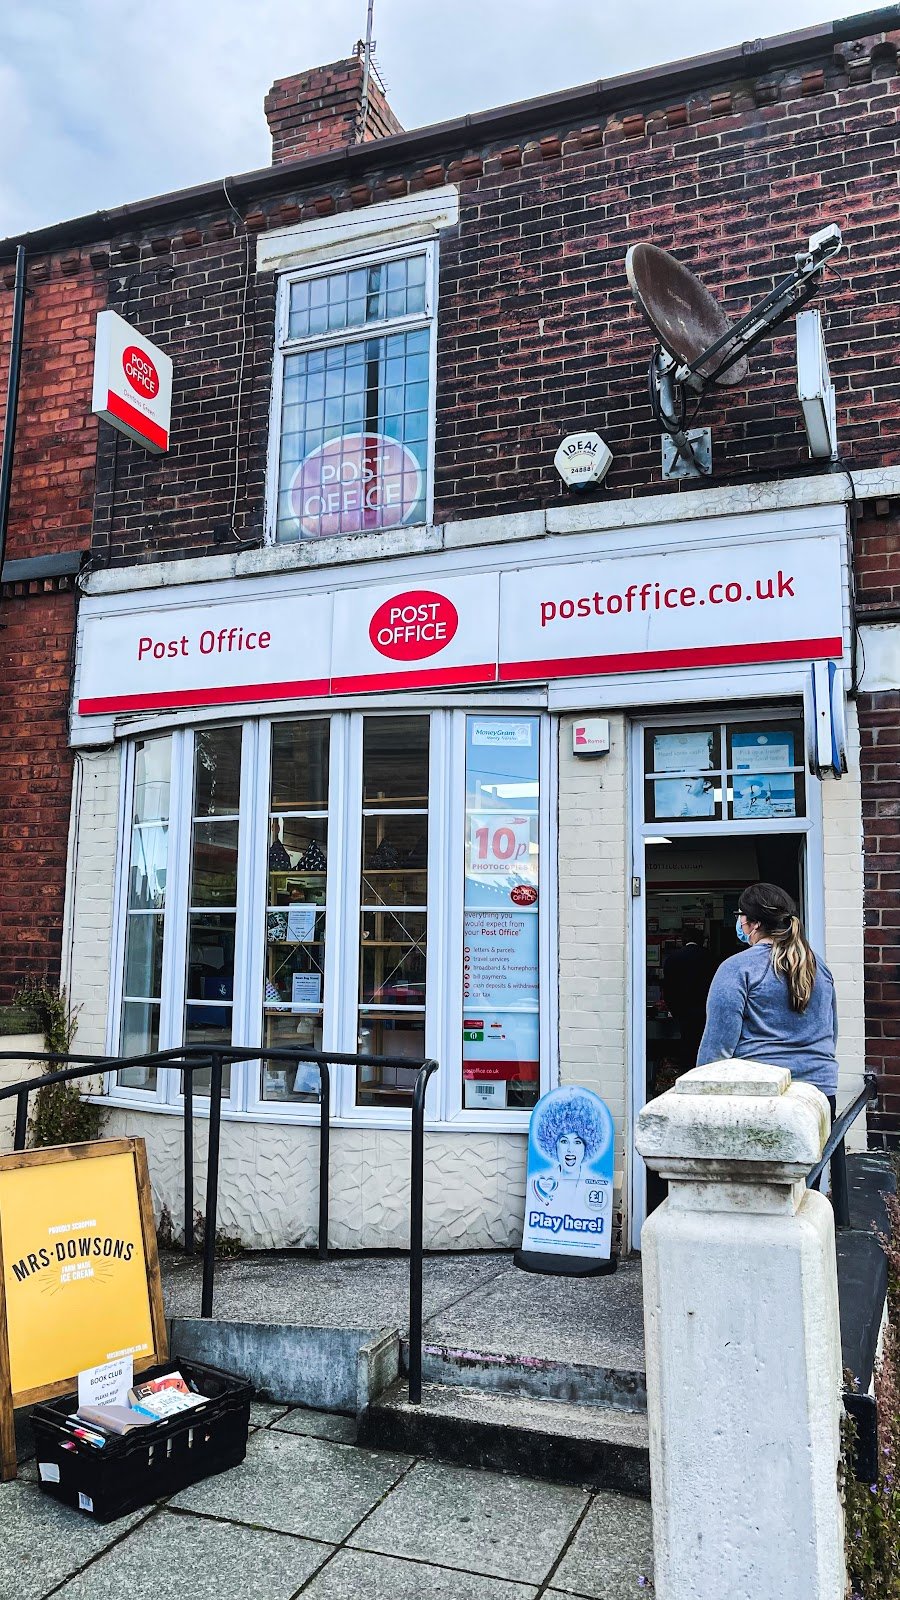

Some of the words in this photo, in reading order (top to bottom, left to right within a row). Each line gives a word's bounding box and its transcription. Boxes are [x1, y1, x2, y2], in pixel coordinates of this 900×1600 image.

[132, 354, 153, 378] POST
[126, 363, 155, 393] OFFICE
[562, 440, 598, 456] IDEAL
[321, 455, 391, 489] POST
[304, 483, 401, 520] OFFICE
[540, 570, 796, 627] postoffice.co.uk
[389, 602, 441, 625] POST
[137, 635, 189, 661] Post
[199, 627, 272, 655] Office
[376, 621, 447, 646] OFFICE
[472, 863, 529, 871] PHOTOCOPIES
[464, 920, 484, 928] would
[509, 920, 525, 928] from
[481, 928, 497, 936] Post
[588, 1190, 604, 1204] £1
[529, 1211, 563, 1233] Play
[563, 1214, 604, 1234] here!
[61, 1273, 72, 1283] ICE
[72, 1267, 95, 1281] CREAM
[90, 1374, 107, 1386] BOOK
[108, 1368, 123, 1379] CLUB
